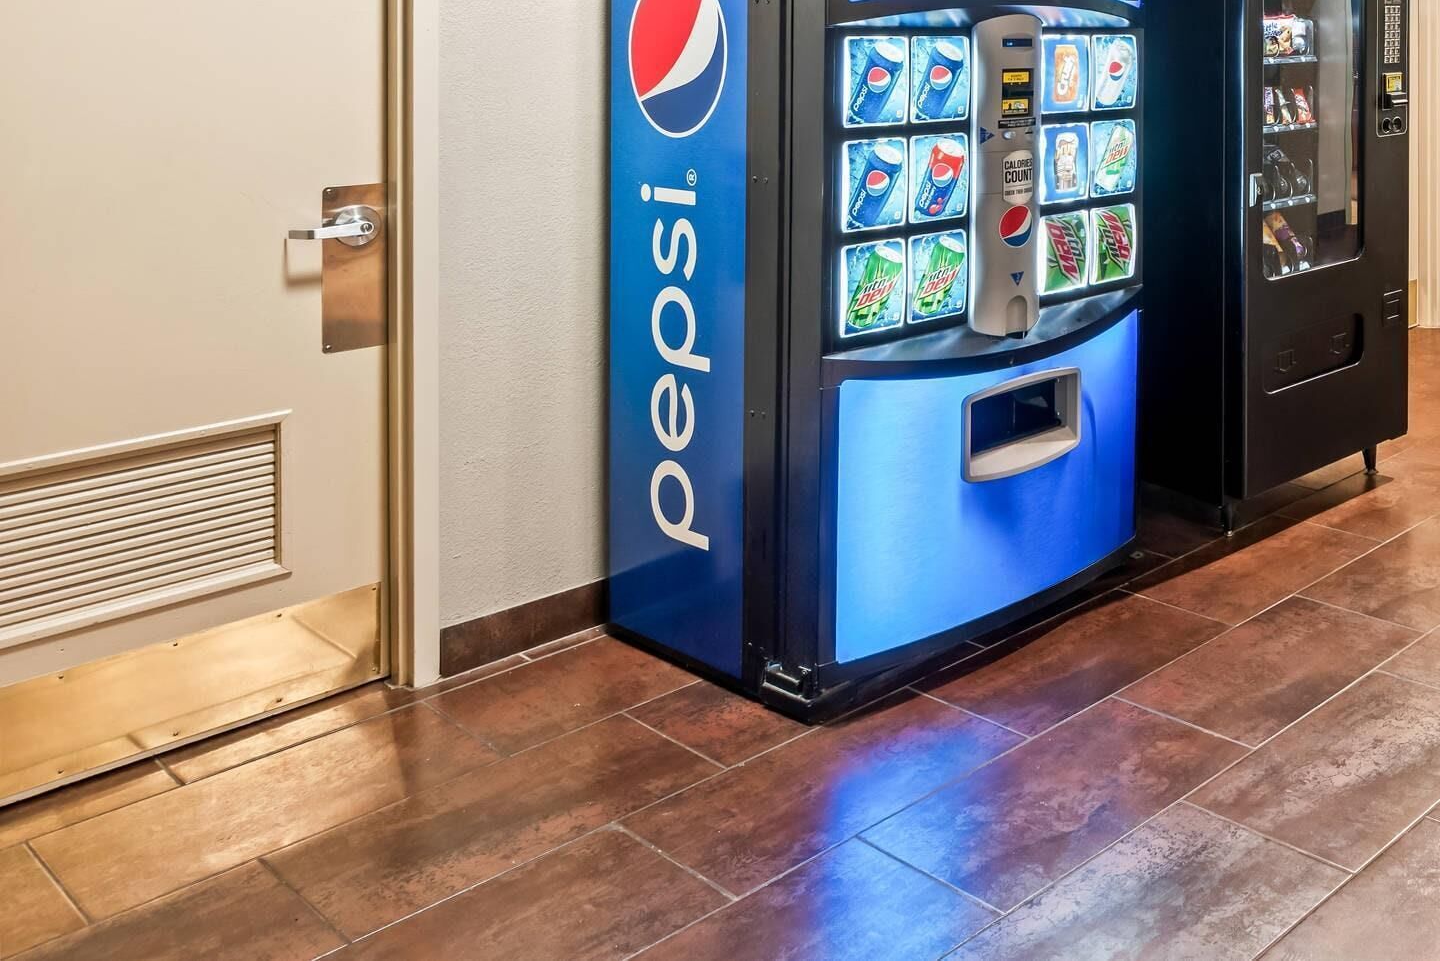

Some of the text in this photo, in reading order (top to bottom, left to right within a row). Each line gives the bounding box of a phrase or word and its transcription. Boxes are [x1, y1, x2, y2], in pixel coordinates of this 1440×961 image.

[853, 85, 869, 112] pepsi
[917, 82, 931, 109] pepsi
[1004, 158, 1033, 170] CALORIES
[1004, 169, 1033, 184] COUNT
[852, 190, 867, 217] pepsi
[919, 181, 932, 208] pepsi
[641, 182, 710, 552] pepsi
